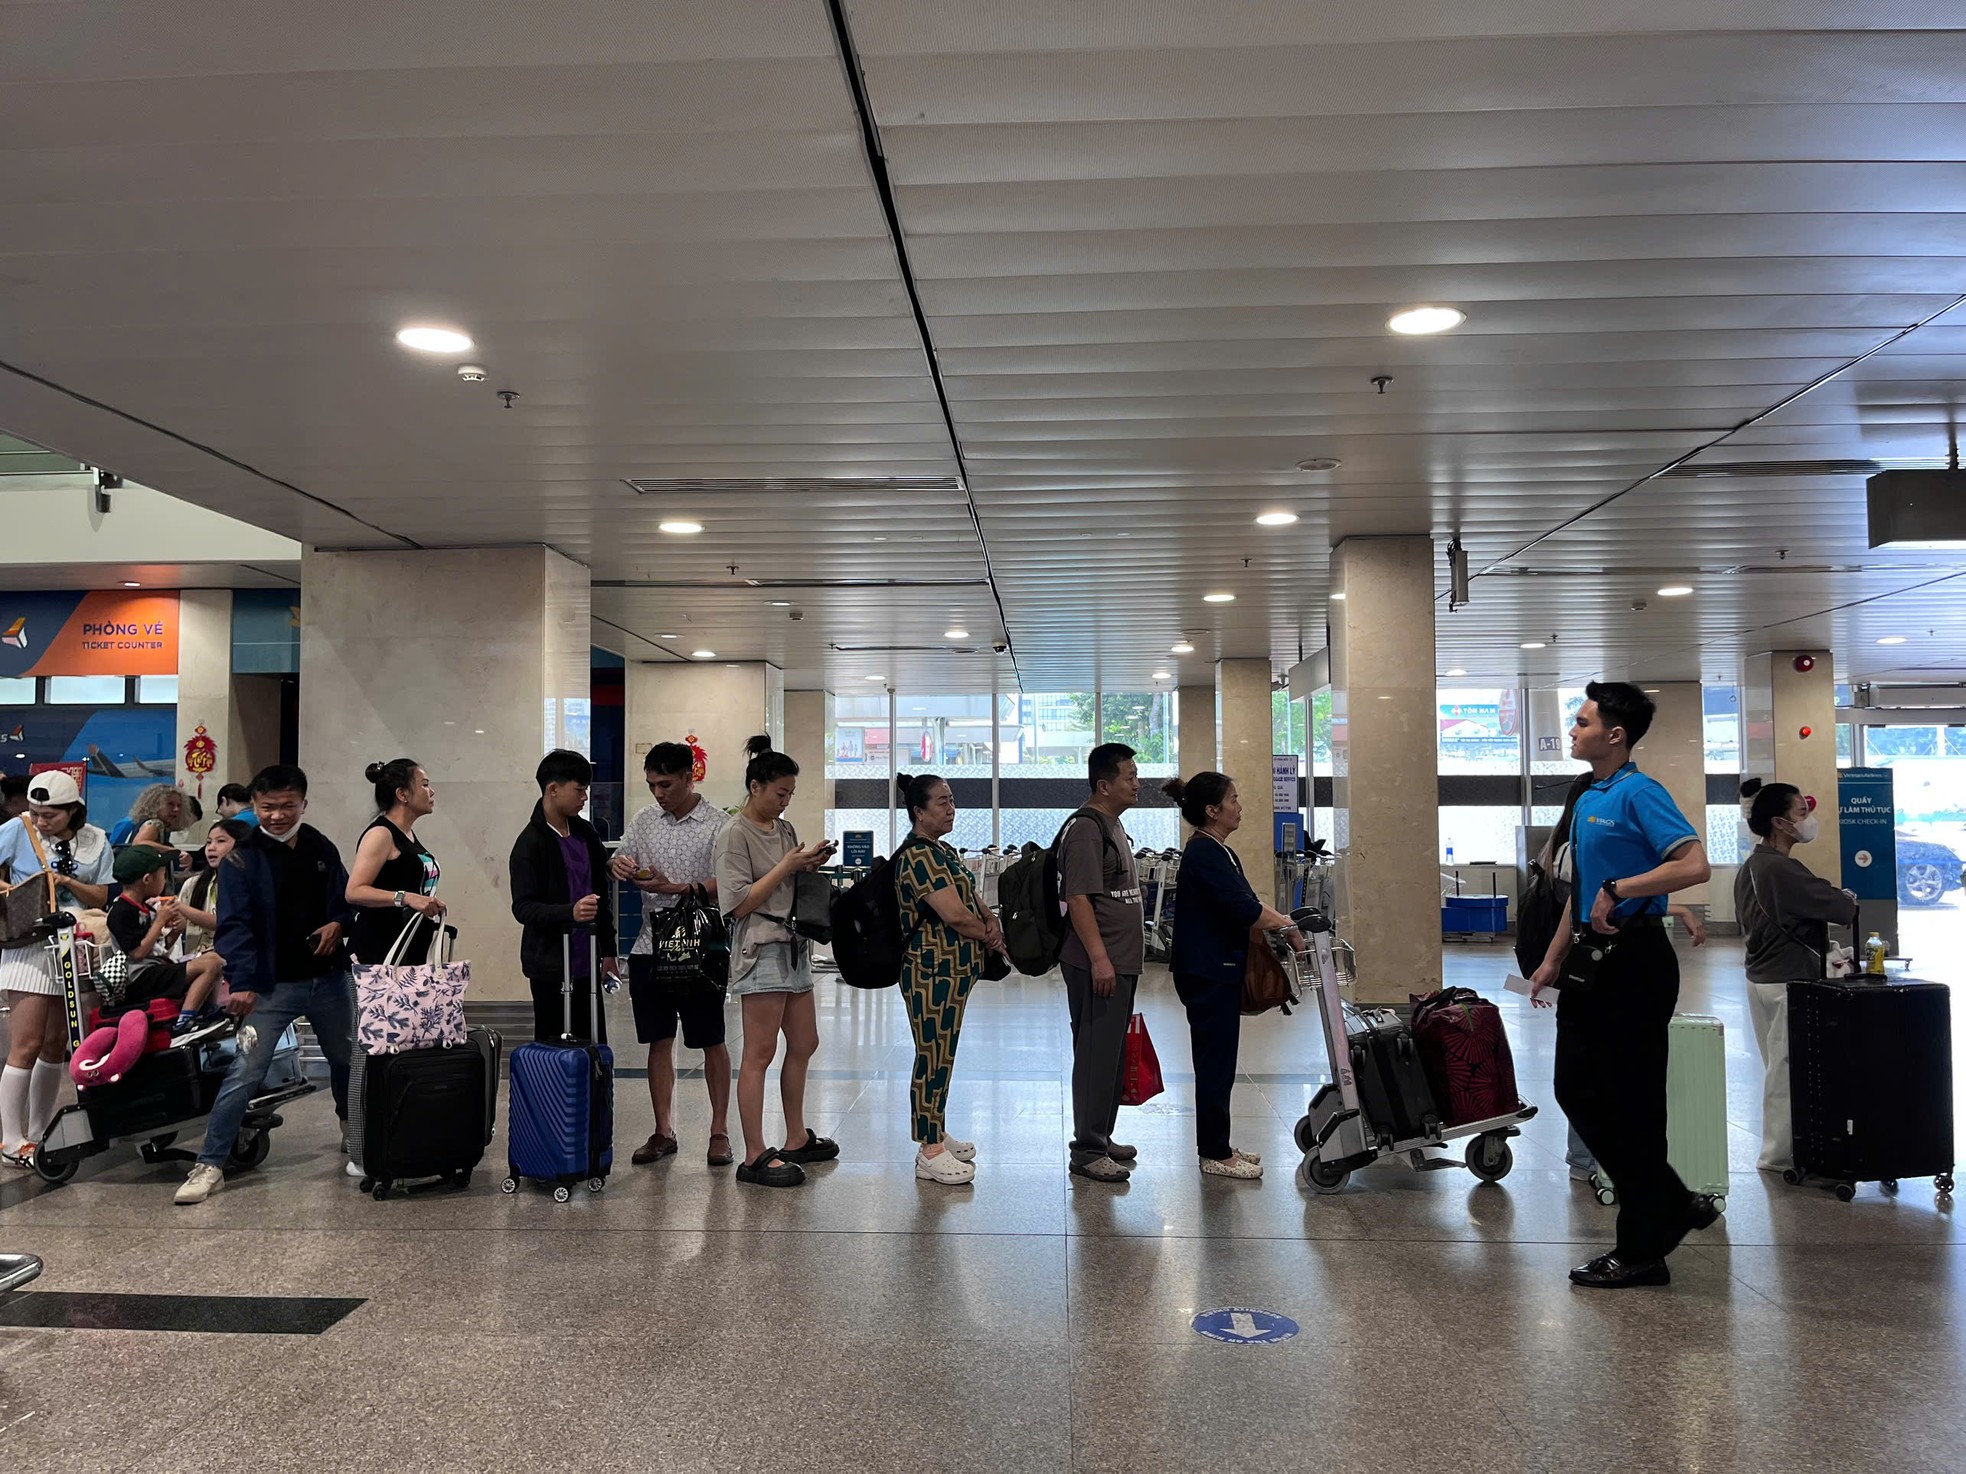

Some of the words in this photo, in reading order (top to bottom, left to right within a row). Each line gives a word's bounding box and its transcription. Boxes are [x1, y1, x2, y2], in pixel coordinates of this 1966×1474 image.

[83, 620, 138, 636] PHÒNG
[144, 620, 163, 635] VÉ
[82, 641, 115, 649] TICKET
[117, 641, 163, 649] COUNTER
[1540, 738, 1561, 750] A-19
[1110, 890, 1121, 898] YOU
[63, 961, 78, 1029] GOLDSUN
